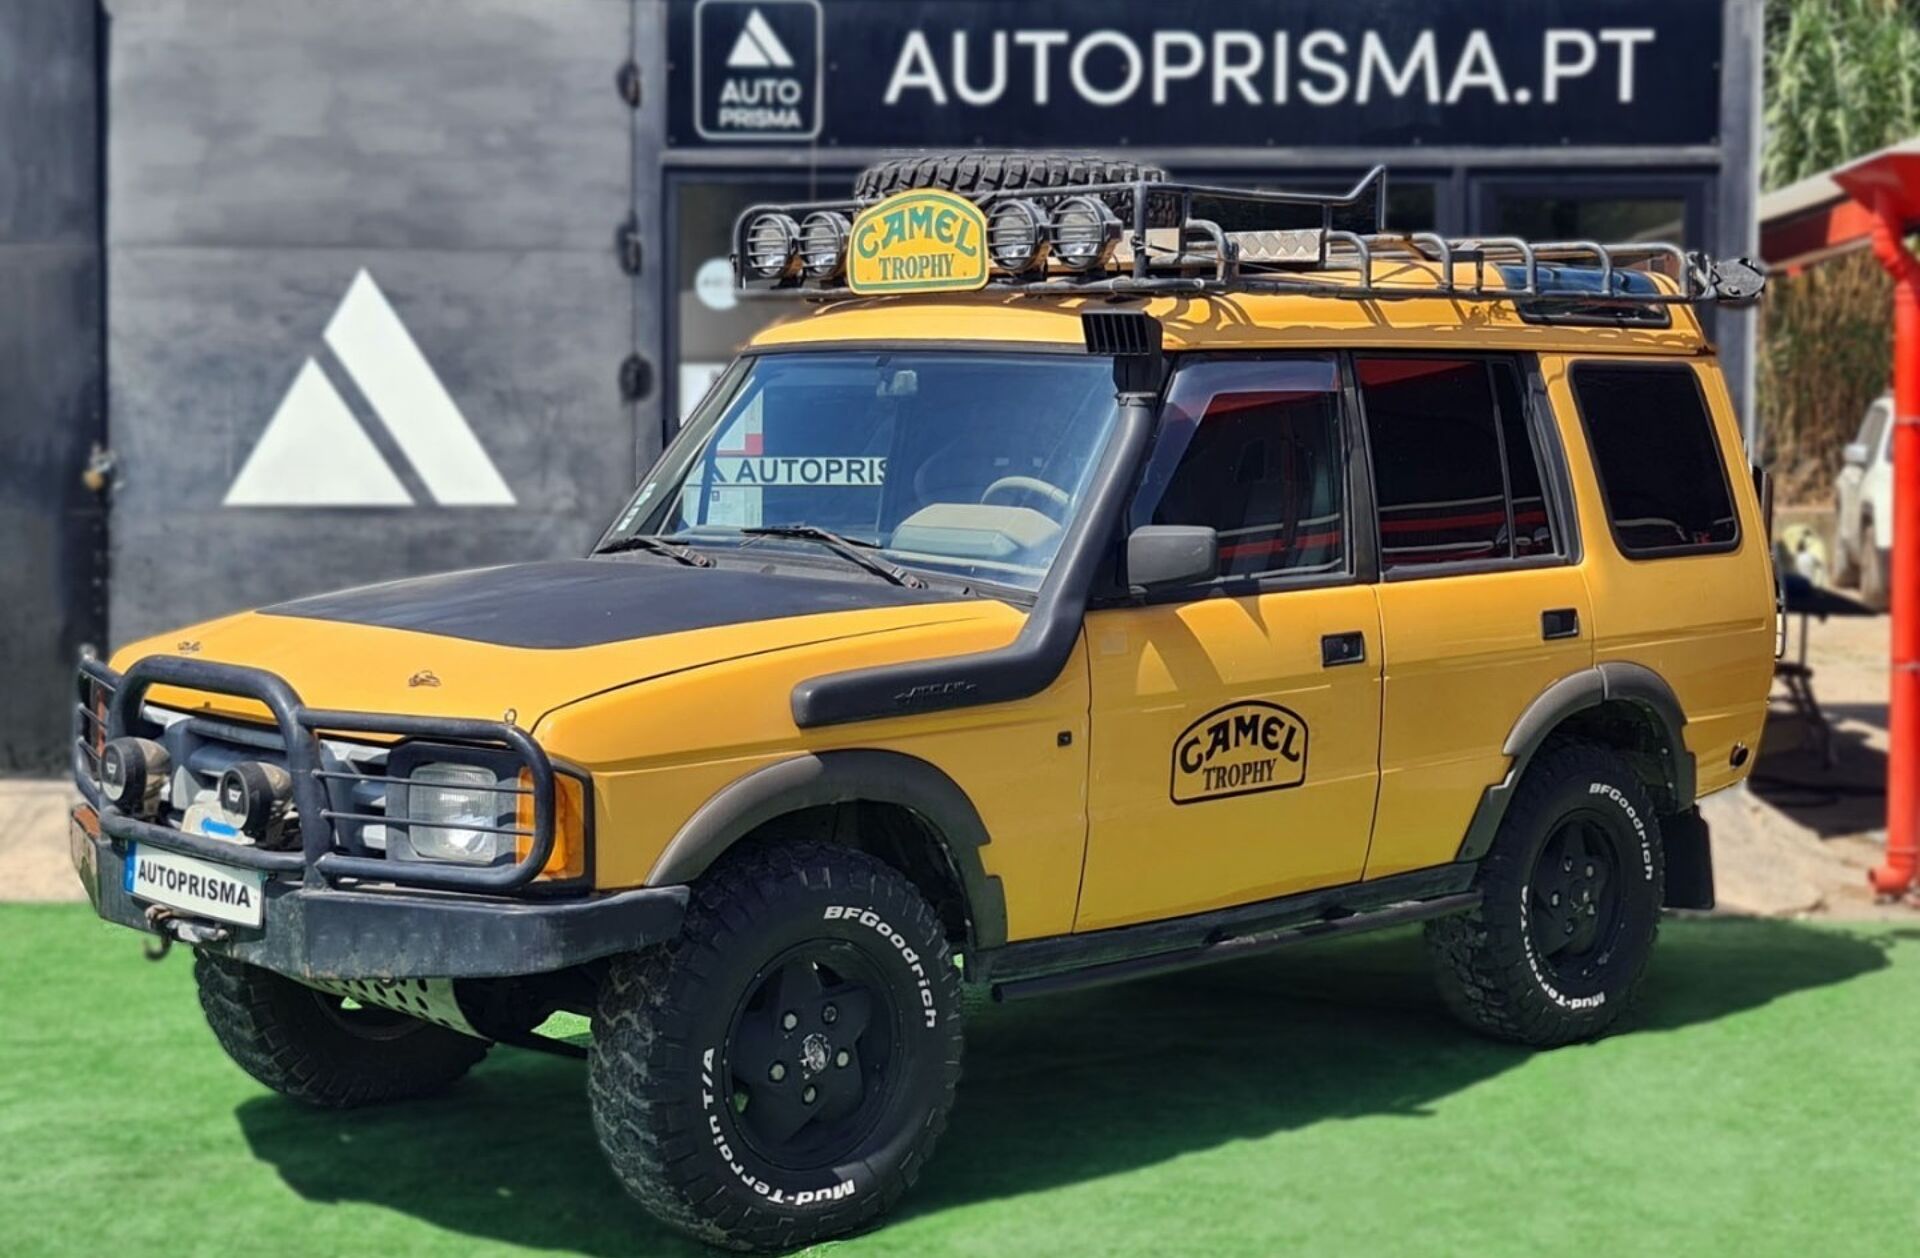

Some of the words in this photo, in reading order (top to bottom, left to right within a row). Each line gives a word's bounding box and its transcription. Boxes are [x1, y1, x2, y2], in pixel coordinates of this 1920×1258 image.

[720, 79, 802, 105] AUTO
[884, 29, 1656, 105] AUTOPRISMA.PT
[718, 108, 802, 128] PRISMA
[857, 206, 977, 259] CAMEL
[879, 253, 955, 281] TROPHY
[1179, 714, 1300, 774] CAMEL
[1203, 759, 1277, 791] TROPHY
[1589, 783, 1654, 880] BFGoodrich
[138, 859, 251, 908] AUTOPRISMA
[823, 905, 936, 1029] BFGoodrich
[702, 1048, 715, 1110] T/A
[709, 1115, 856, 1206] Mud-Terrain
